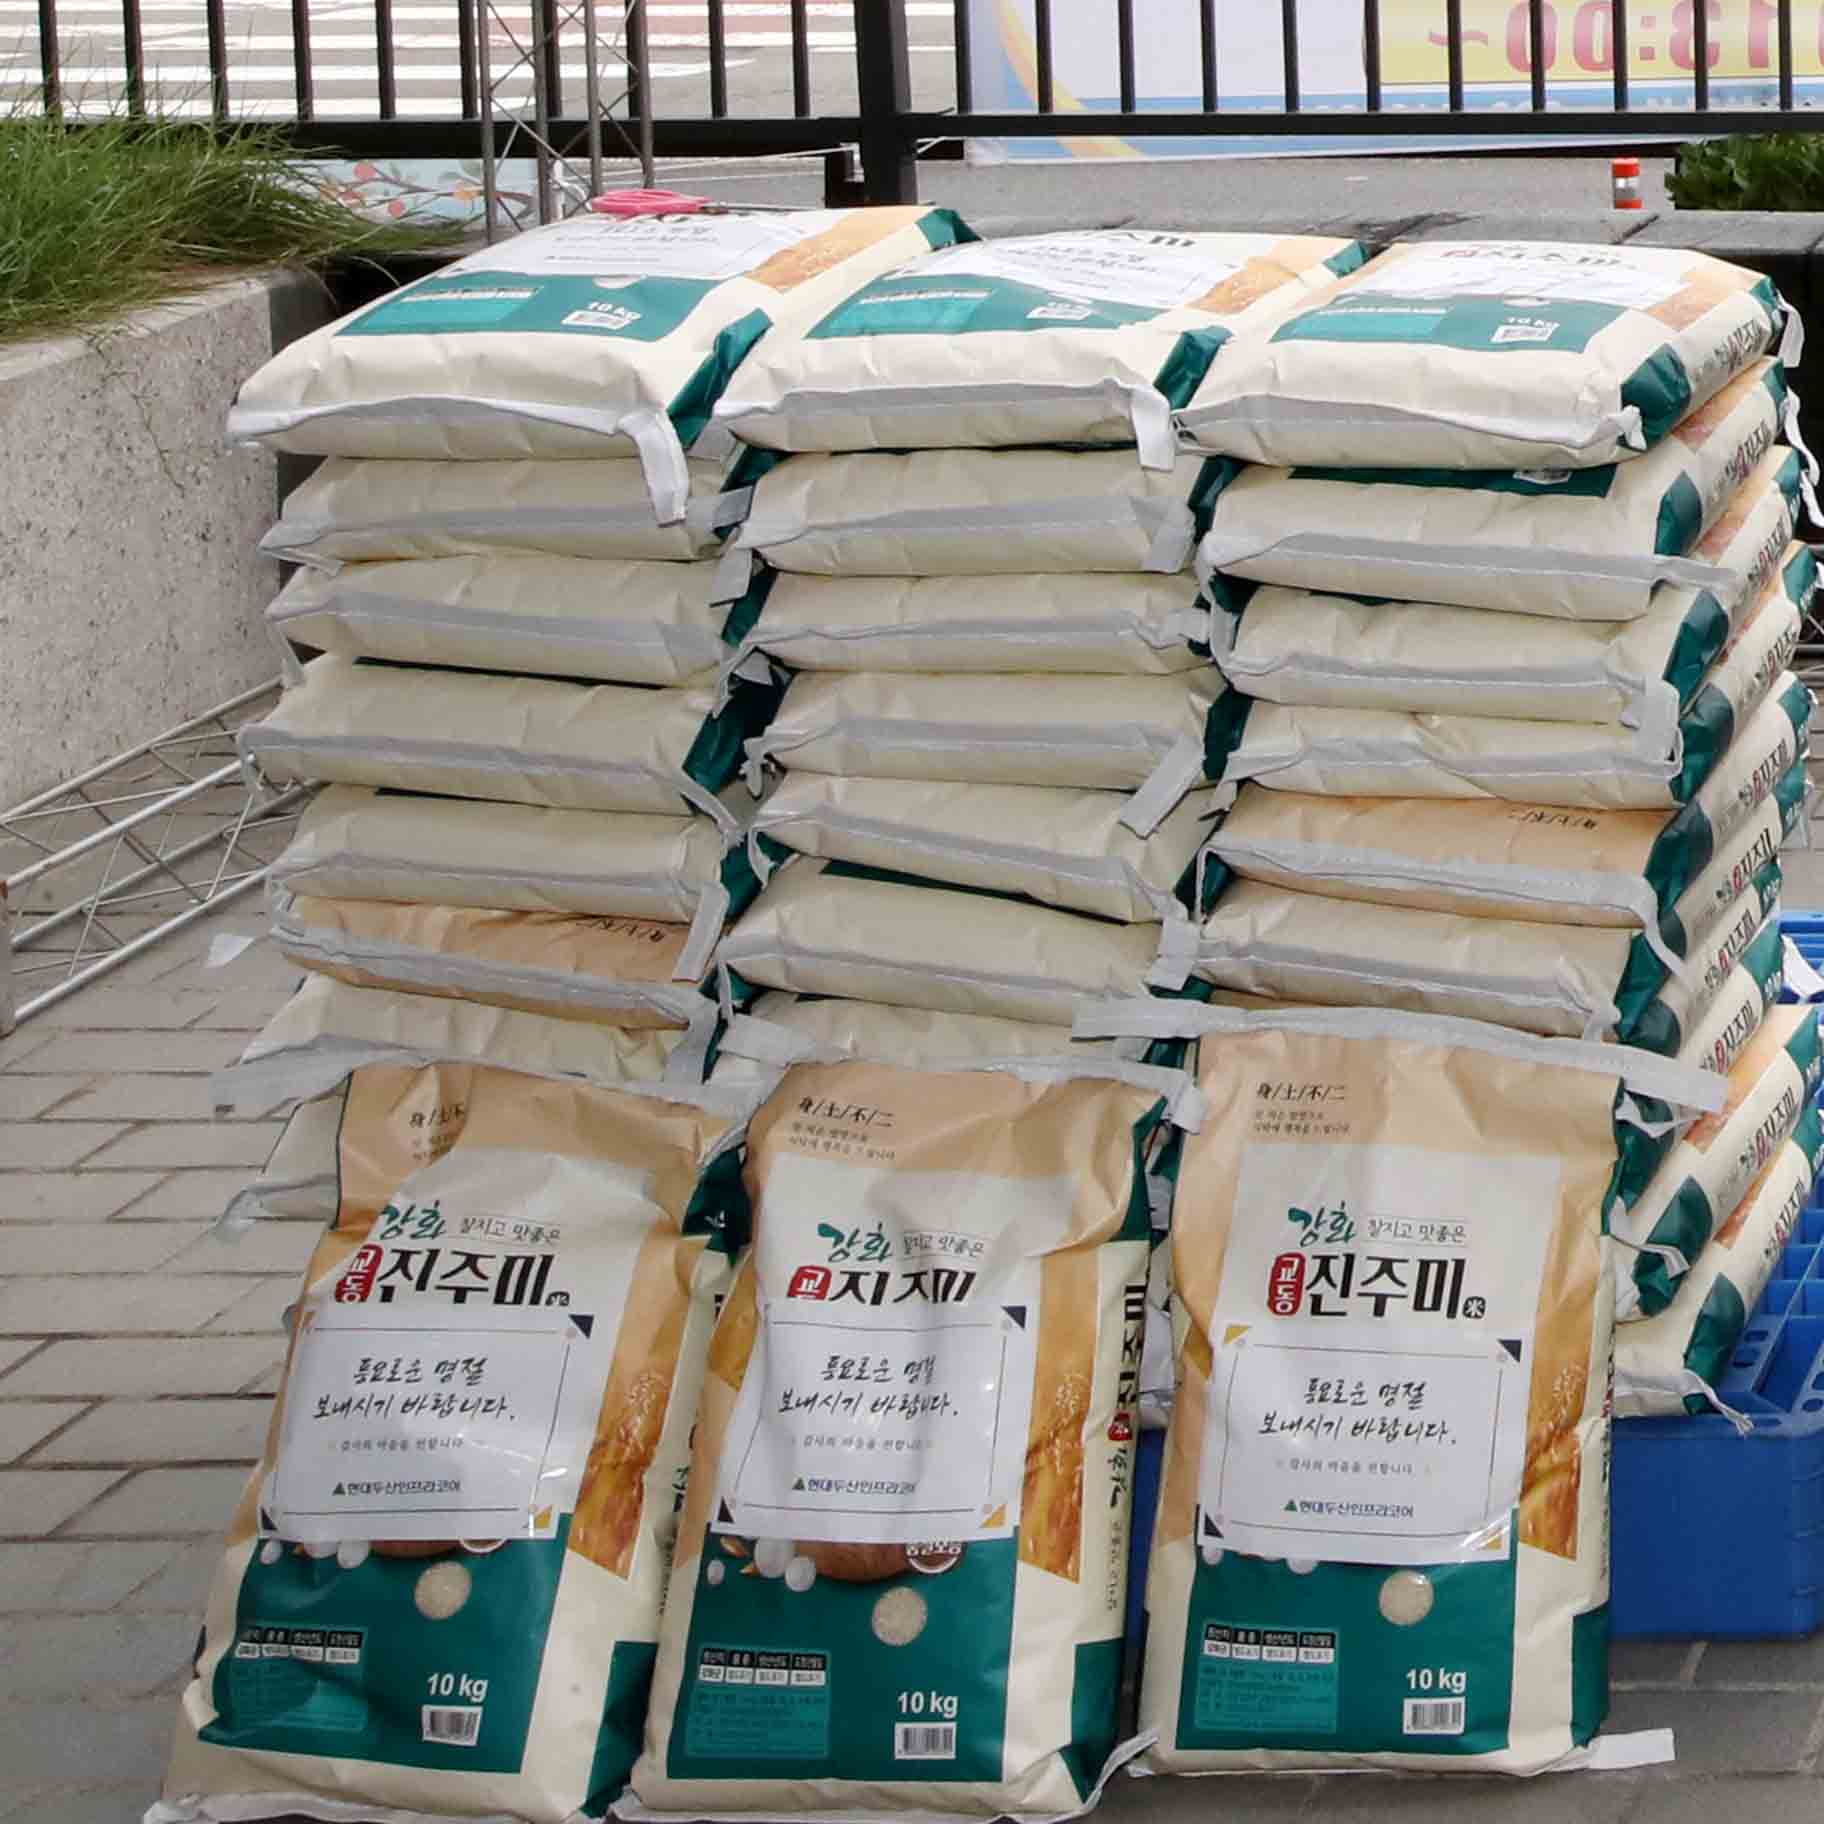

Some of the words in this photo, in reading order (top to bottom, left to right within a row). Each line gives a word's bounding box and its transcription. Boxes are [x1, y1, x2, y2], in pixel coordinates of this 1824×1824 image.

[379, 1200, 448, 1242] 강화
[1287, 1204, 1357, 1247] 강화
[1367, 1218, 1414, 1239] 찰지고
[1419, 1221, 1466, 1241] 맛좋은
[818, 1223, 895, 1263] 강화
[1273, 1254, 1300, 1314] 교동
[1304, 1253, 1468, 1319] 진주미
[353, 1358, 421, 1385] 풍요로운
[434, 1357, 487, 1387] 명절
[821, 1355, 891, 1383] 풍요로운
[312, 1394, 393, 1421] 보내시기
[401, 1394, 516, 1422] 바랍니다.
[780, 1392, 861, 1414] 보내시기
[1304, 1378, 1369, 1407] 풍요로운
[1378, 1380, 1427, 1410] 명절
[1258, 1412, 1342, 1437] 보내시기
[1351, 1416, 1458, 1446] 바랍니다.
[427, 1673, 455, 1696] 10
[458, 1674, 489, 1703] kg
[1406, 1669, 1432, 1690] 10
[1437, 1669, 1467, 1695] kg
[897, 1692, 925, 1714] 10
[929, 1692, 959, 1718] kg
